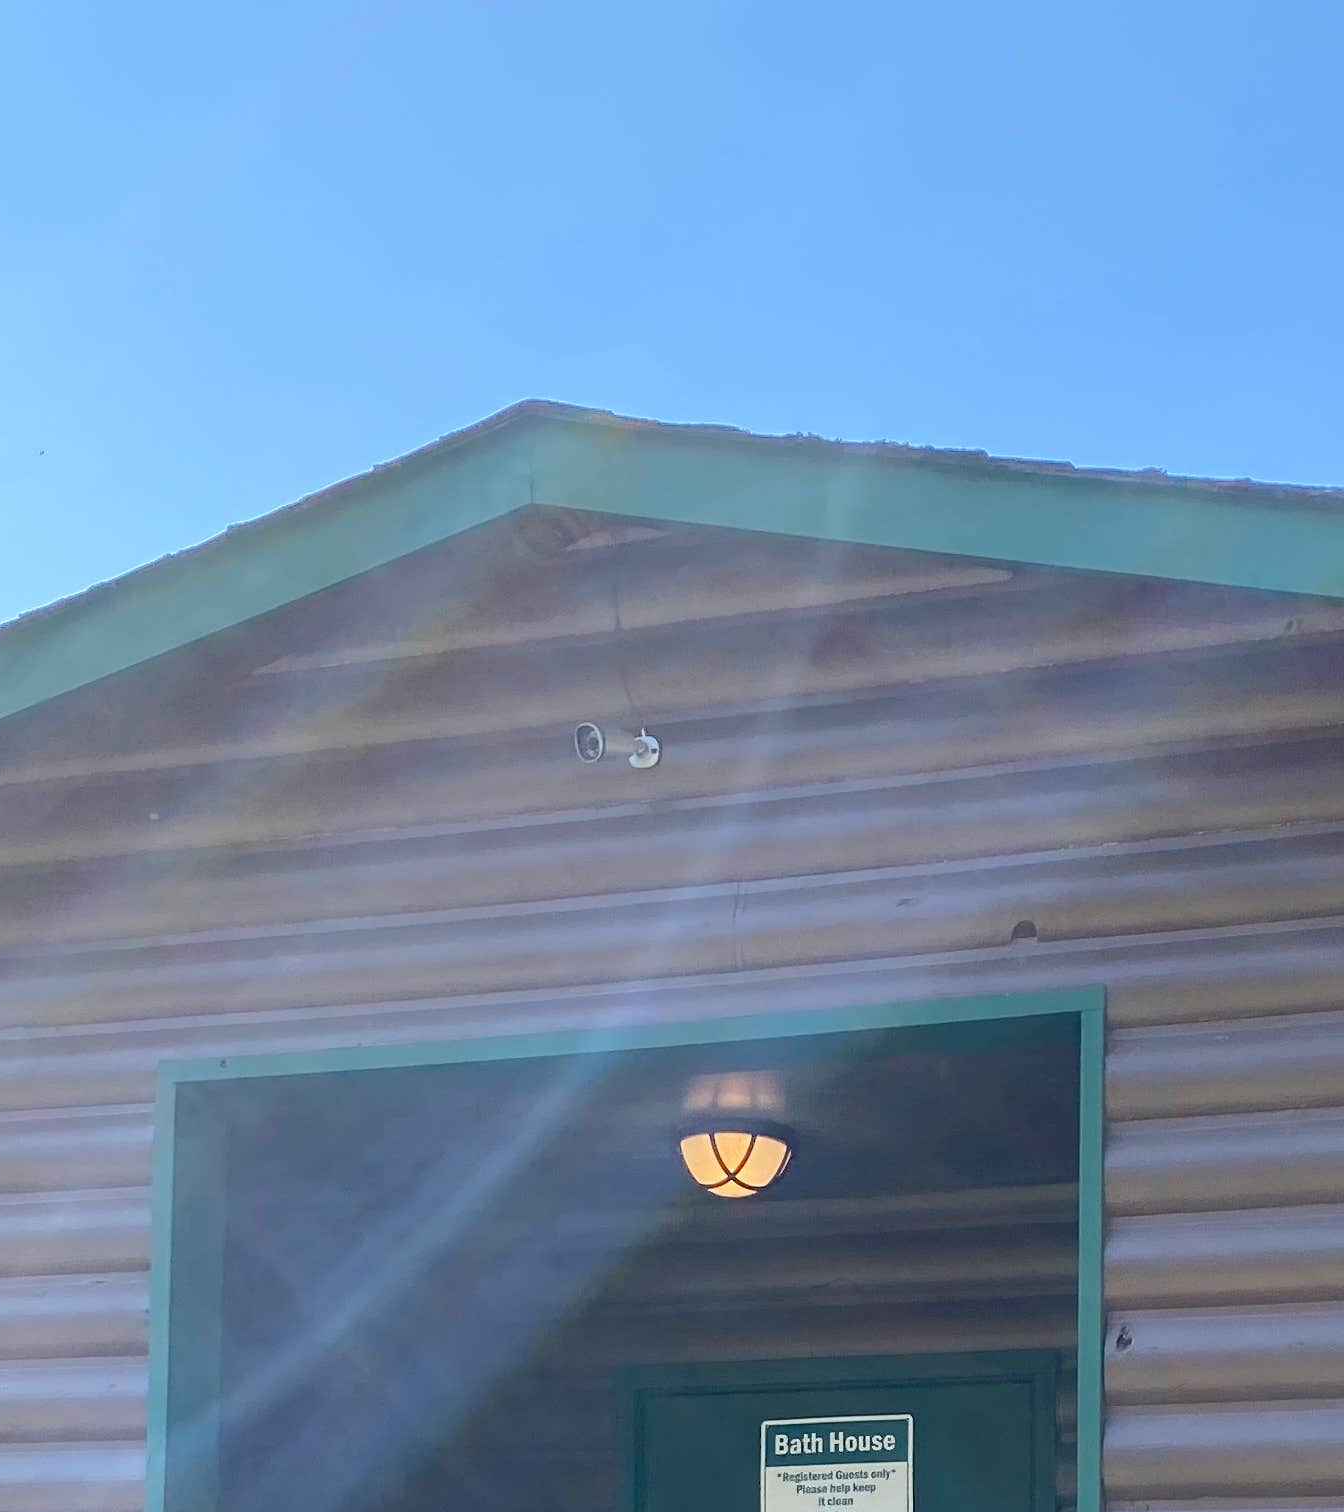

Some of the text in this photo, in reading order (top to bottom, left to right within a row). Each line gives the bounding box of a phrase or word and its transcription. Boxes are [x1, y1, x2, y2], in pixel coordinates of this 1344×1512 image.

[774, 1431, 896, 1455] Bath House
[835, 1469, 869, 1480] Guests
[796, 1482, 877, 1495] Please help keep
[827, 1496, 854, 1507] clean
